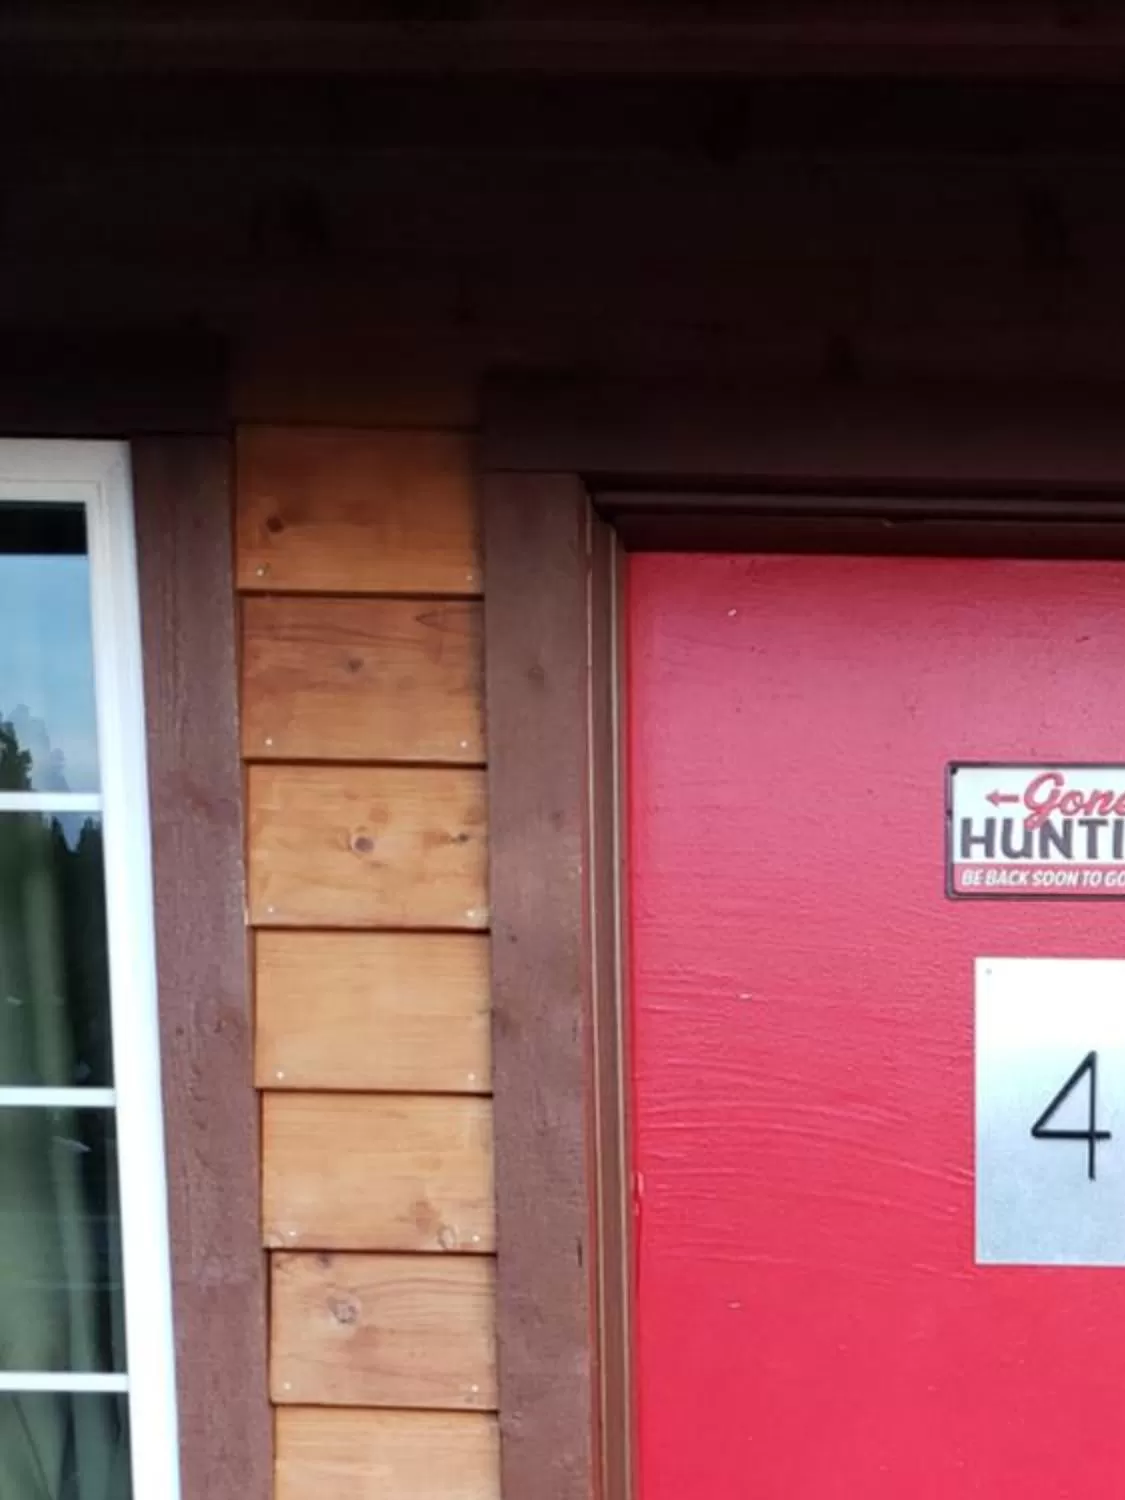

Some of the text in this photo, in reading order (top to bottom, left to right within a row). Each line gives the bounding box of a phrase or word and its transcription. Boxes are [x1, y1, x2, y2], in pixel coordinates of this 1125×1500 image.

[961, 869, 983, 886] BE
[986, 869, 1028, 886] BACK
[1032, 869, 1078, 887] SOON
[1082, 870, 1100, 887] TO
[1031, 1050, 1112, 1181] 4
